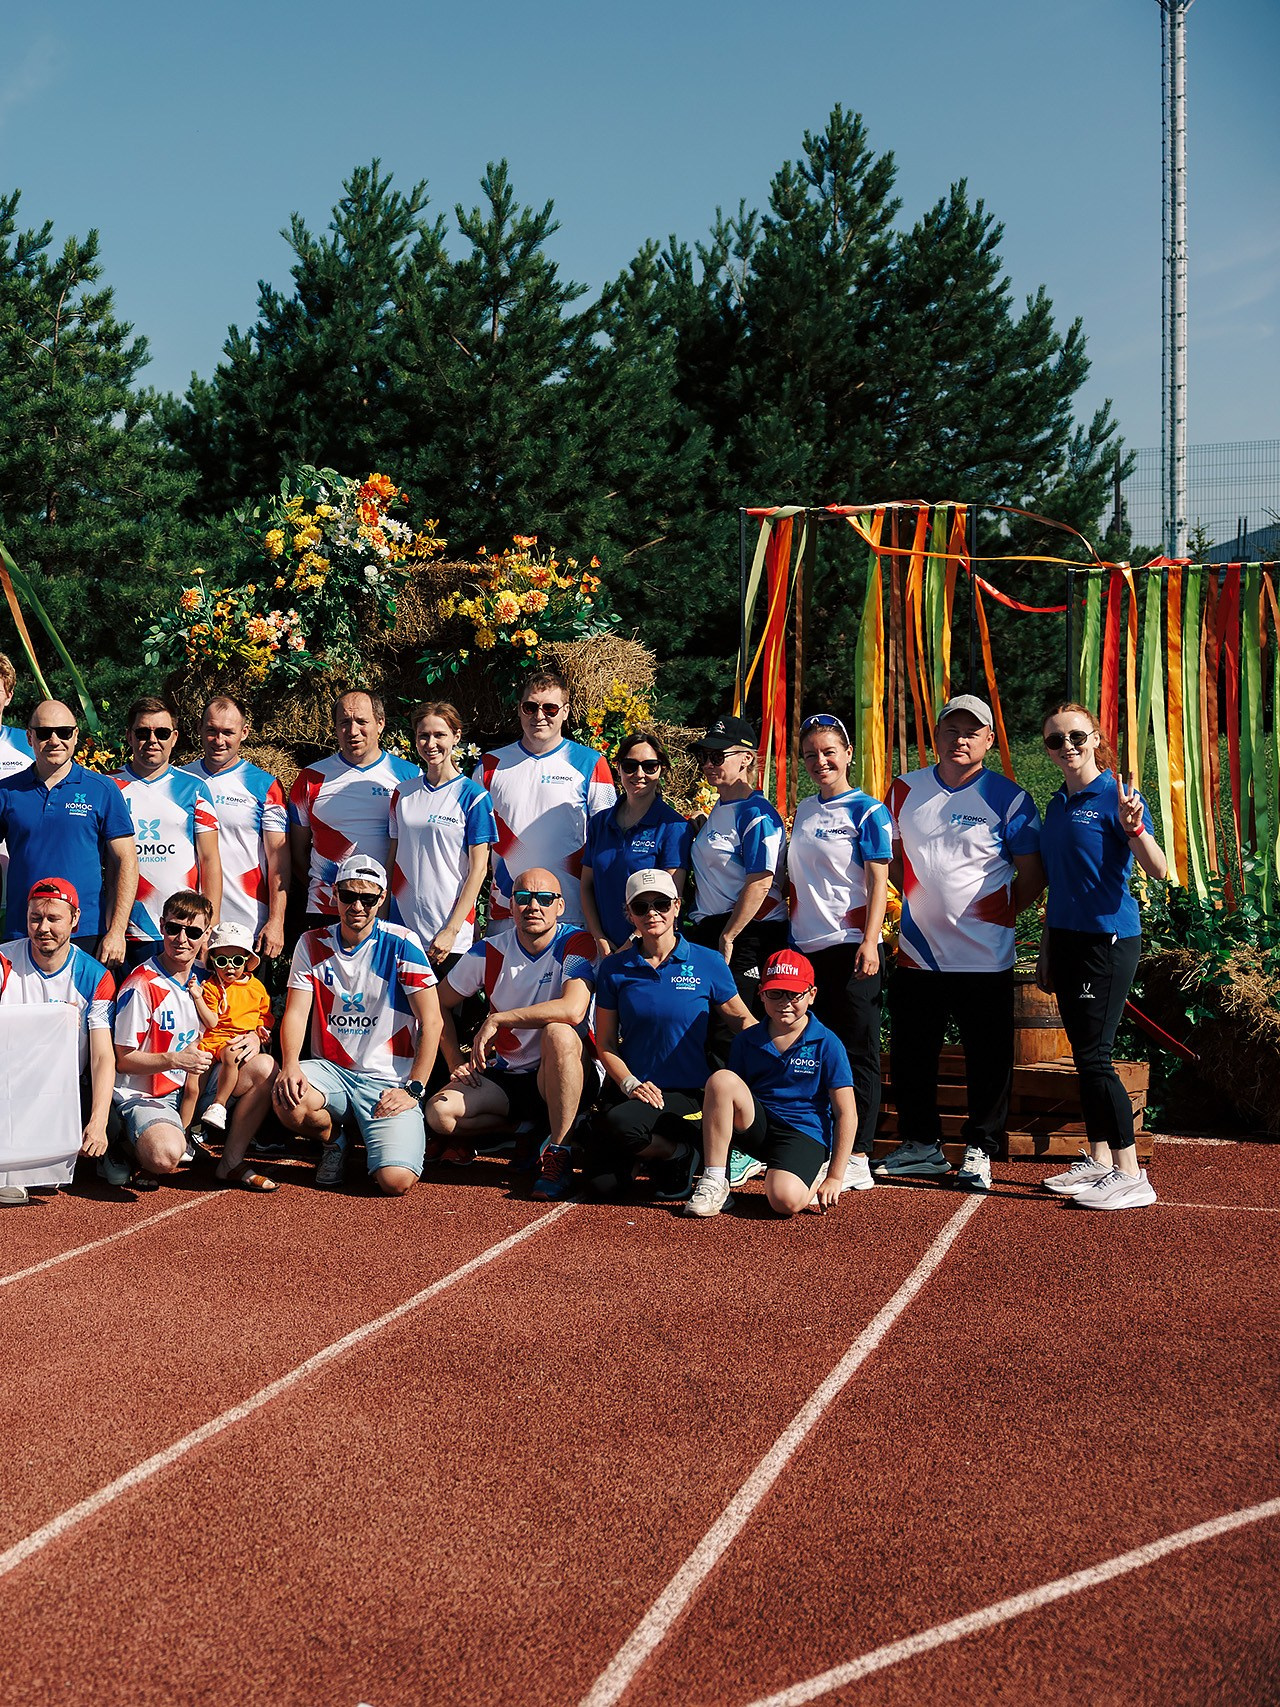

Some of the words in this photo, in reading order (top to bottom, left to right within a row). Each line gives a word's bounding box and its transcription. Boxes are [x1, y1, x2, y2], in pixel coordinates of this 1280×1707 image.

[65, 802, 93, 811] КОМОС
[963, 815, 987, 823] КОМОС
[631, 840, 656, 848] КОМОС
[136, 844, 176, 855] ОМОС
[324, 966, 334, 987] 6
[671, 975, 701, 985] КОМОС
[160, 1010, 175, 1030] 15
[327, 1014, 379, 1028] КОМОС
[790, 1058, 820, 1068] КОМОС
